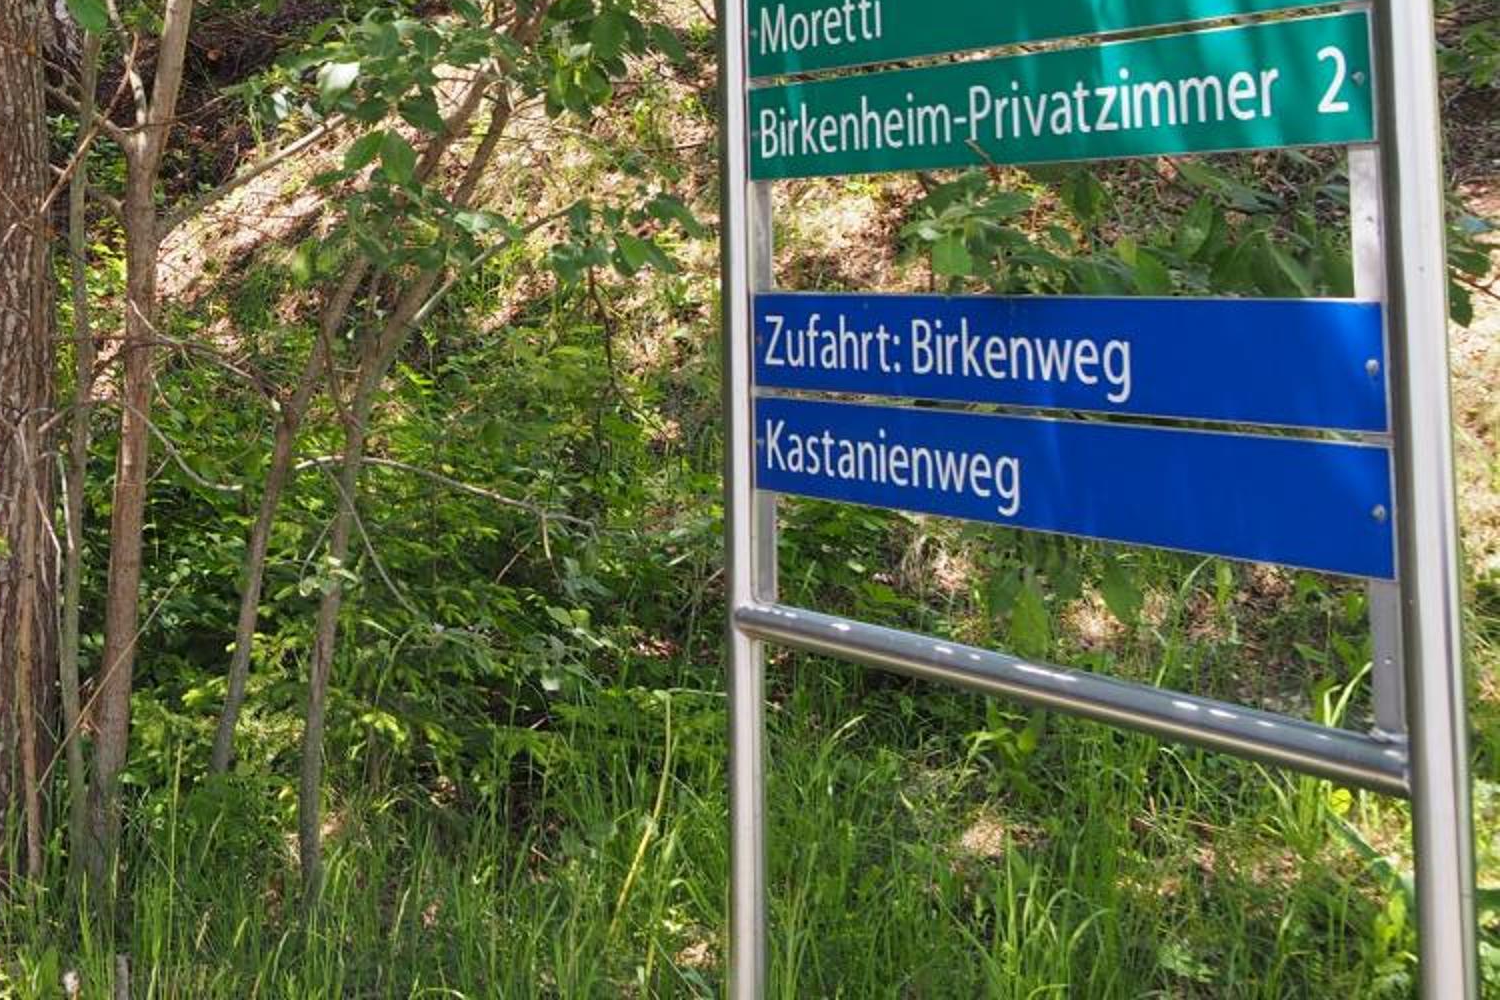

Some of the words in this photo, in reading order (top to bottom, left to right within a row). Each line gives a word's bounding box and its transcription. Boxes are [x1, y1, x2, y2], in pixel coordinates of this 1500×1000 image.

[759, 67, 1279, 159] Birkenheim-Privatzimmer
[1316, 46, 1349, 115] 2
[764, 314, 902, 374] Zufahrt:
[912, 317, 1132, 402] Birkenweg
[765, 419, 1021, 515] Kastanienweg
